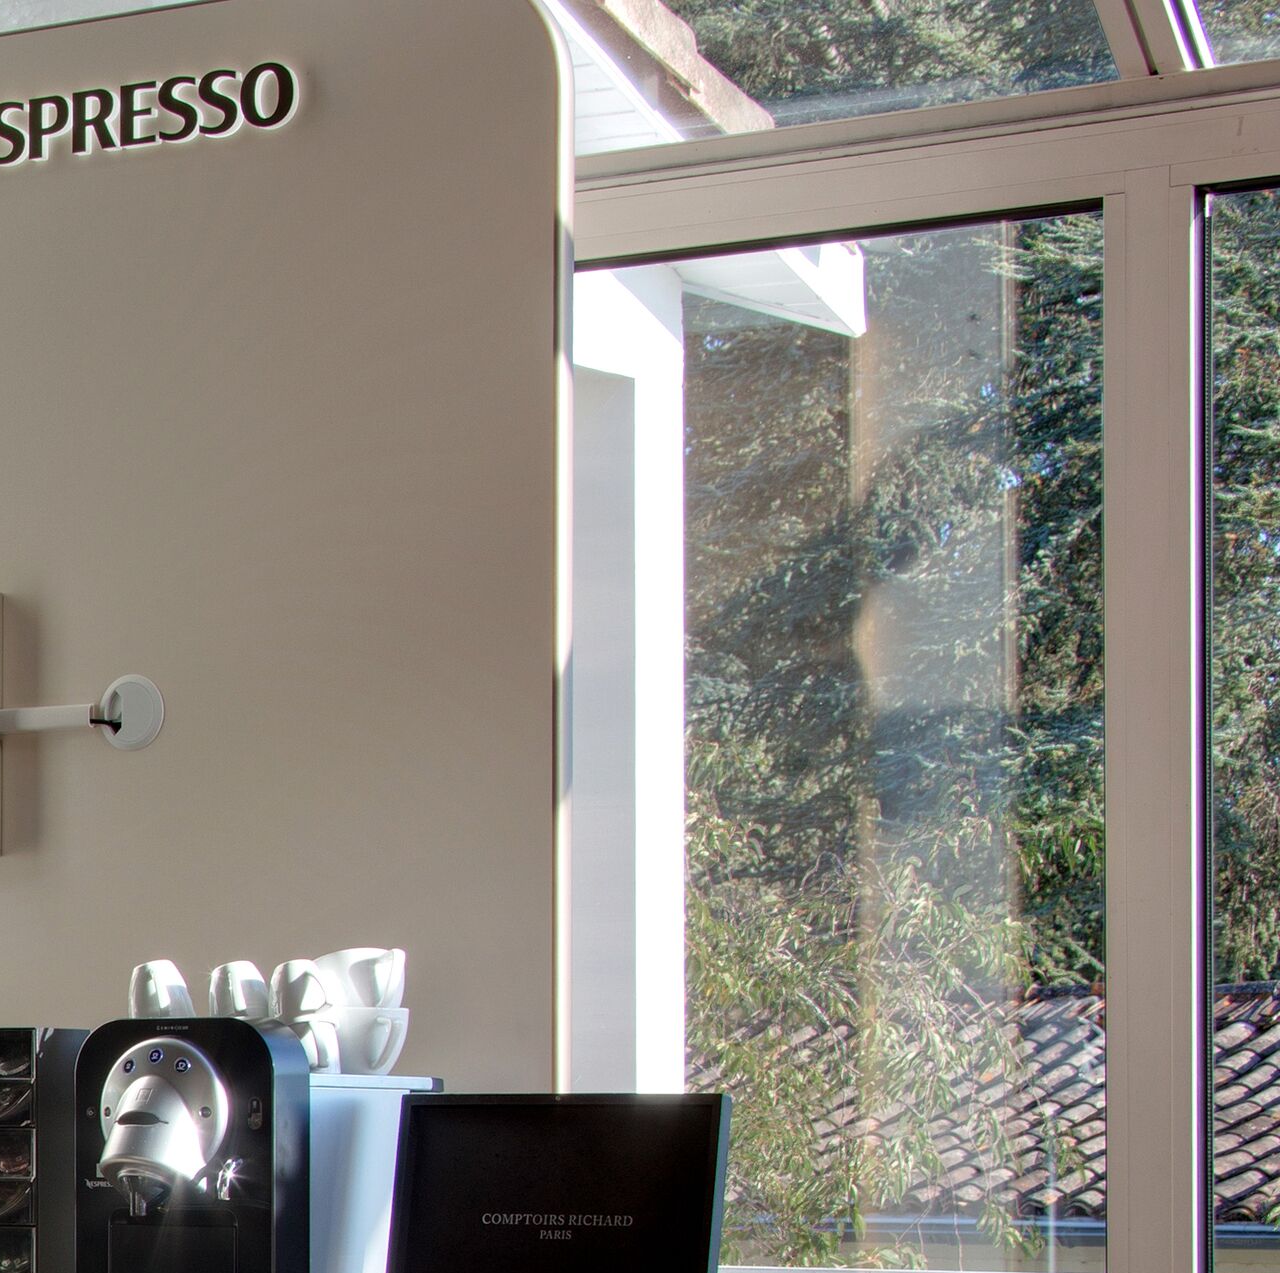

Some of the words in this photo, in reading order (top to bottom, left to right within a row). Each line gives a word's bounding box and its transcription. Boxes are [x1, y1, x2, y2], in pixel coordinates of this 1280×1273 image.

[482, 1213, 565, 1226] COMPTOIRS
[568, 1215, 633, 1227] RICHARD
[540, 1230, 572, 1239] PARIS
